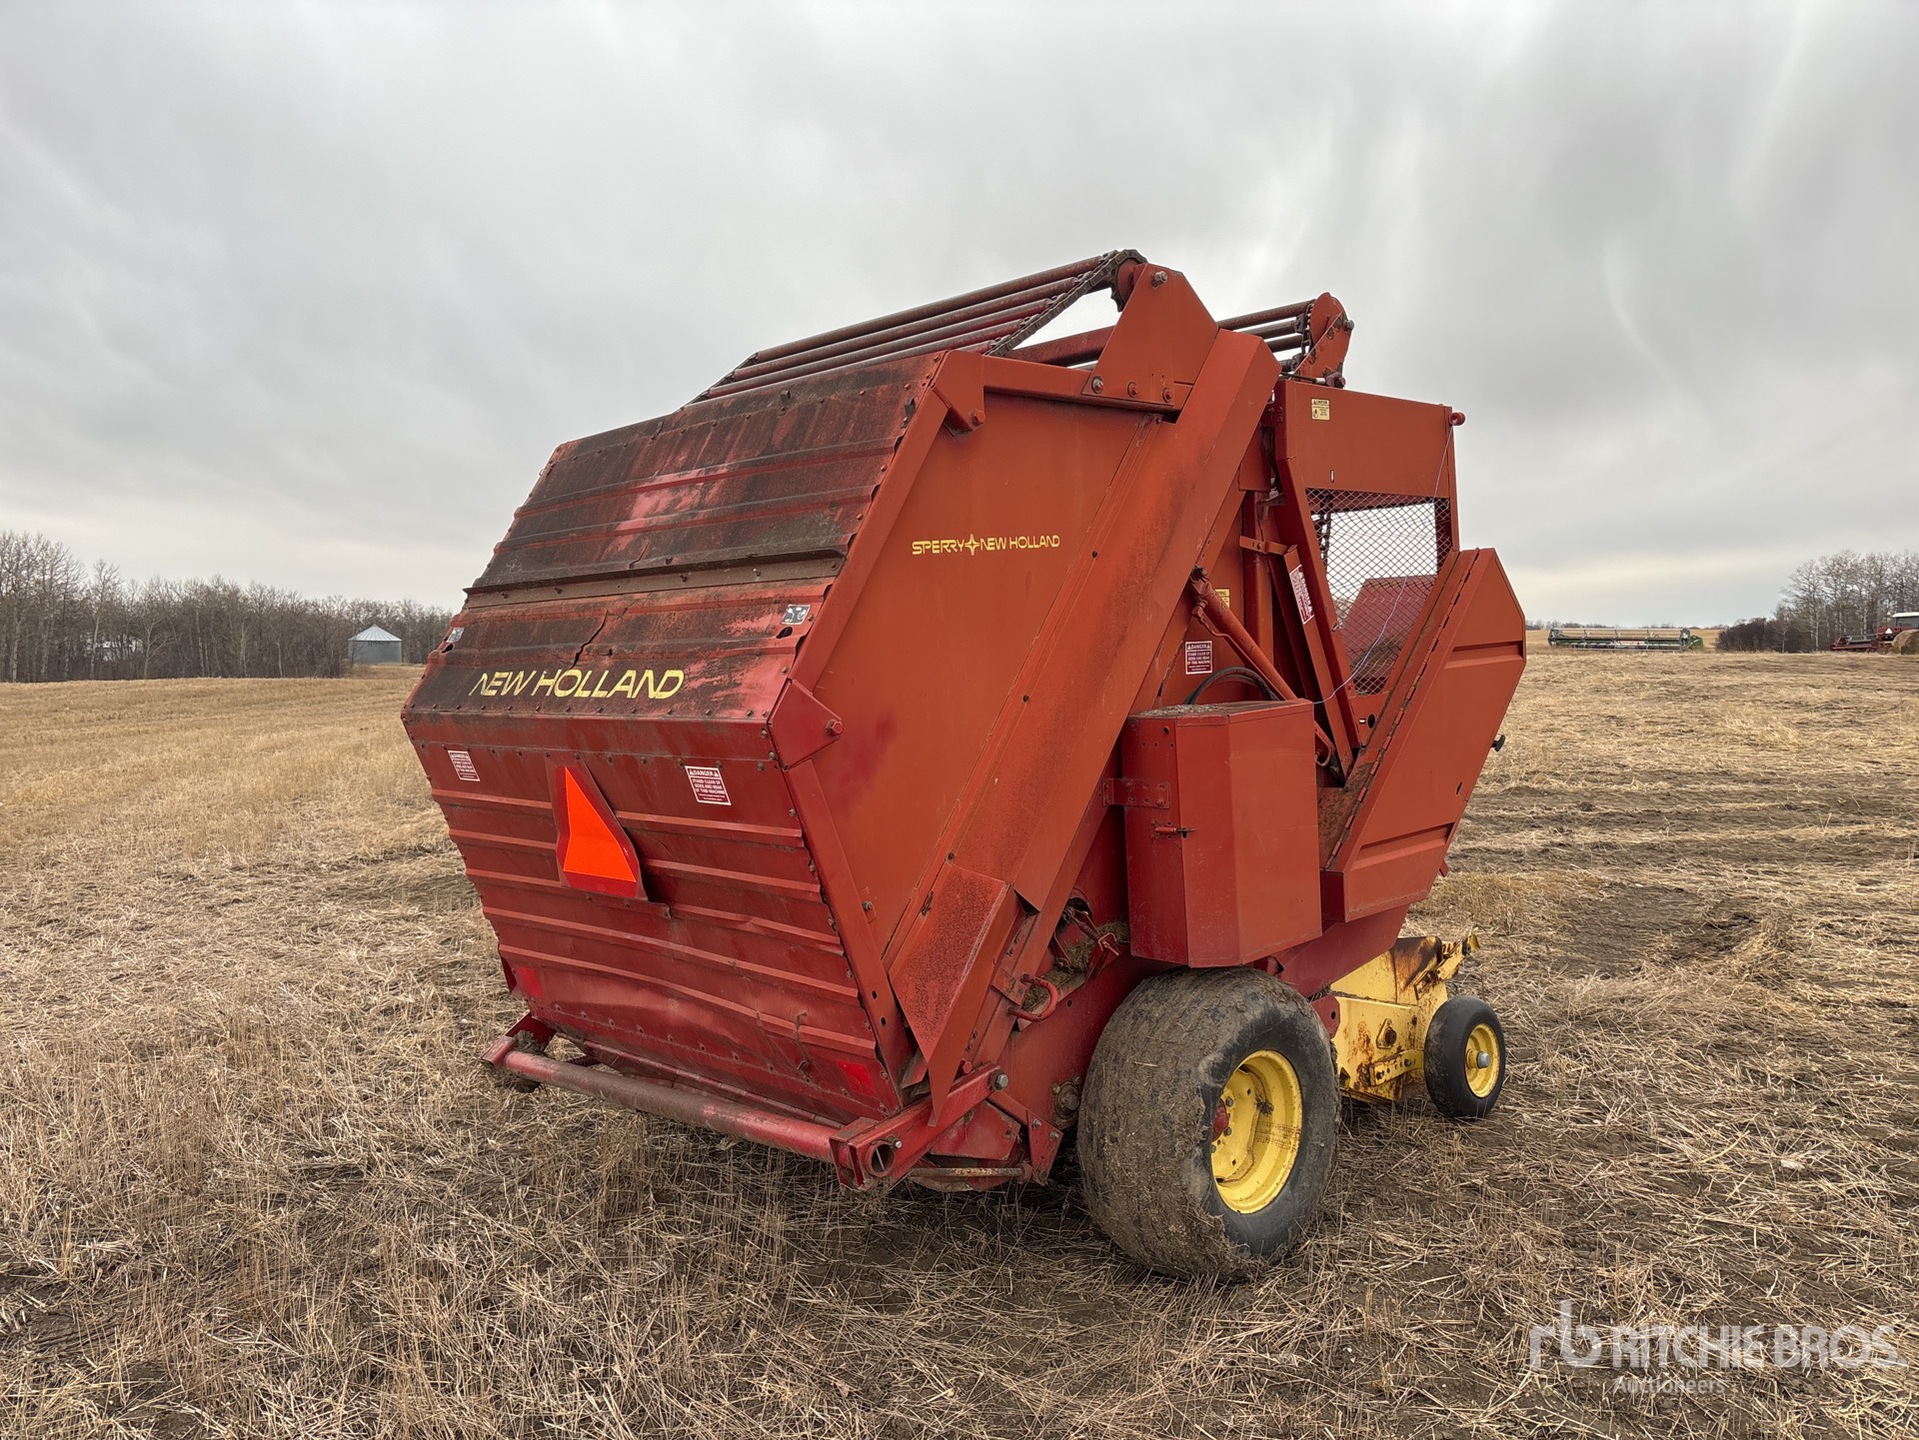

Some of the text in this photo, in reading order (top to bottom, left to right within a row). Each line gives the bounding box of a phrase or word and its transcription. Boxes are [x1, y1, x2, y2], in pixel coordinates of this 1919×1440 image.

[912, 535, 1061, 555] SPERRY NEW HOLLAND
[468, 669, 685, 699] NEW HOLLAND
